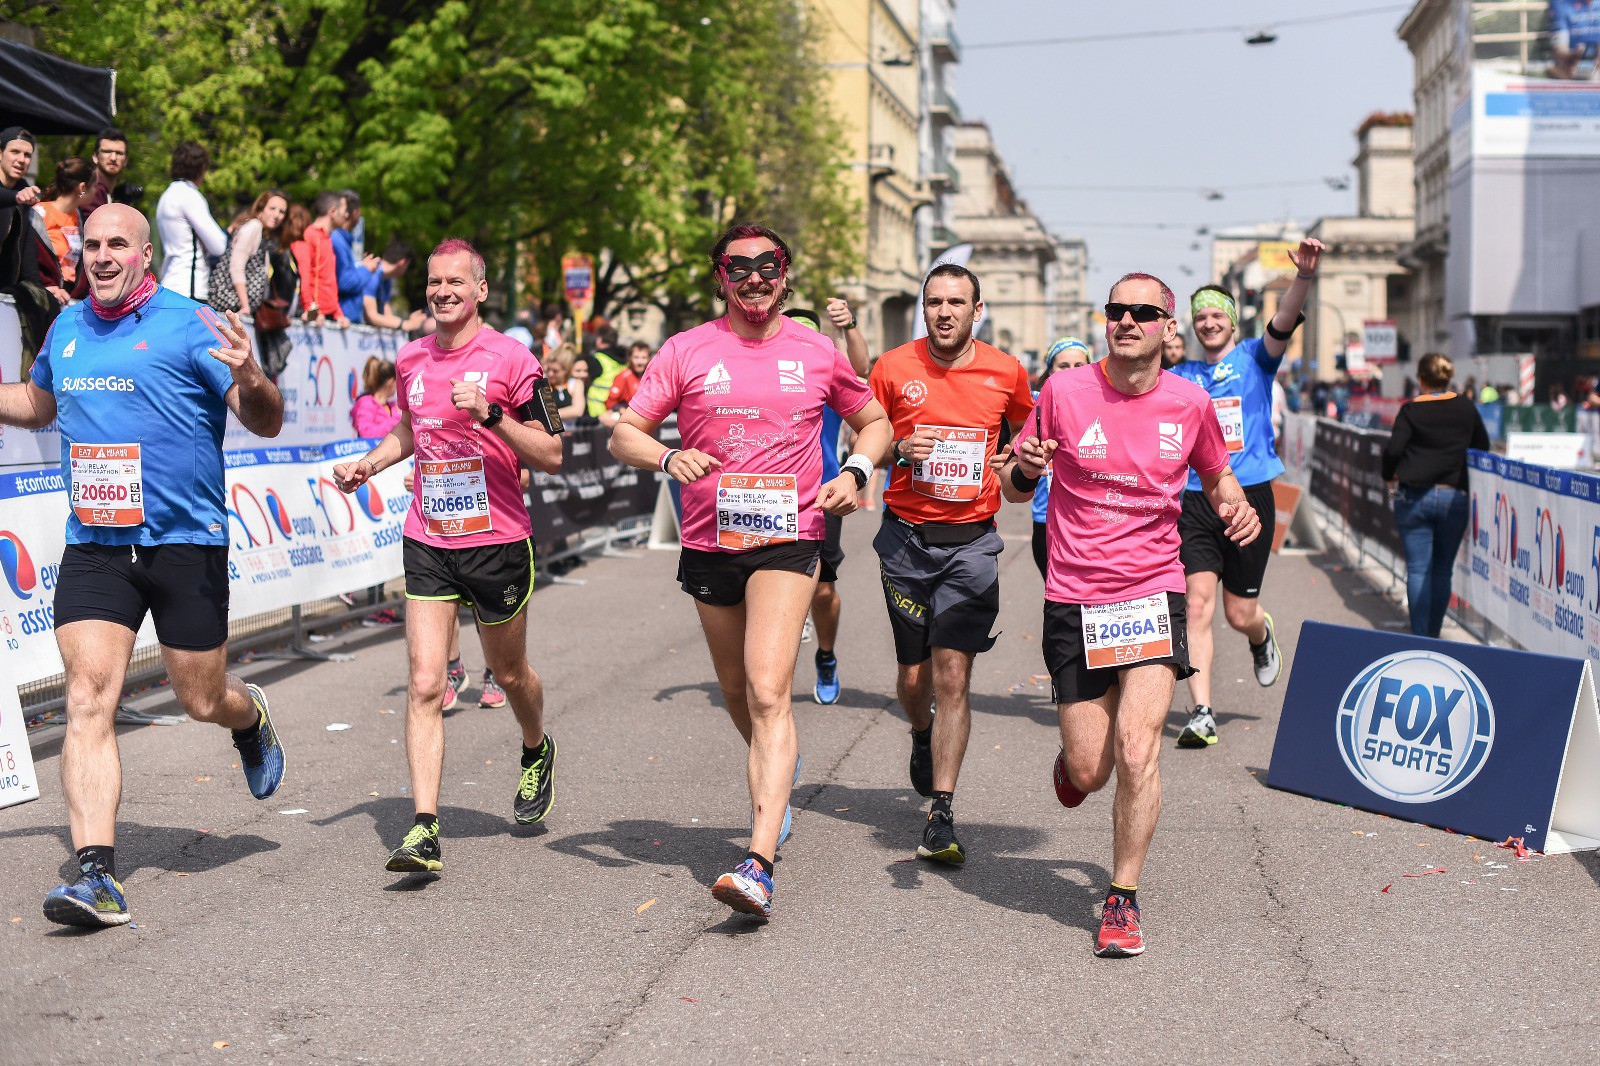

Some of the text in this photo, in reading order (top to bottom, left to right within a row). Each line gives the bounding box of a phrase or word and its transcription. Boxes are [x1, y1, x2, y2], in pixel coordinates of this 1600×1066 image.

[78, 448, 92, 456] EA7
[1078, 447, 1107, 455] MILANO
[928, 461, 968, 477] 1619D
[15, 471, 66, 493] #corricon
[730, 477, 749, 486] EA7
[81, 484, 128, 501] 2066D
[934, 484, 959, 496] EA7
[430, 495, 475, 513] 2066B
[92, 509, 117, 522] EA7
[732, 512, 784, 531] 2066C
[441, 518, 465, 532] EA7
[742, 534, 770, 548] EA7
[1566, 570, 1585, 606] europ
[1108, 604, 1146, 613] MARATHON
[1555, 598, 1584, 640] assistance
[1099, 618, 1156, 639] 2066A
[1114, 644, 1144, 660] EA7
[1368, 676, 1465, 751] FOX
[1362, 737, 1453, 777] SPORTS
